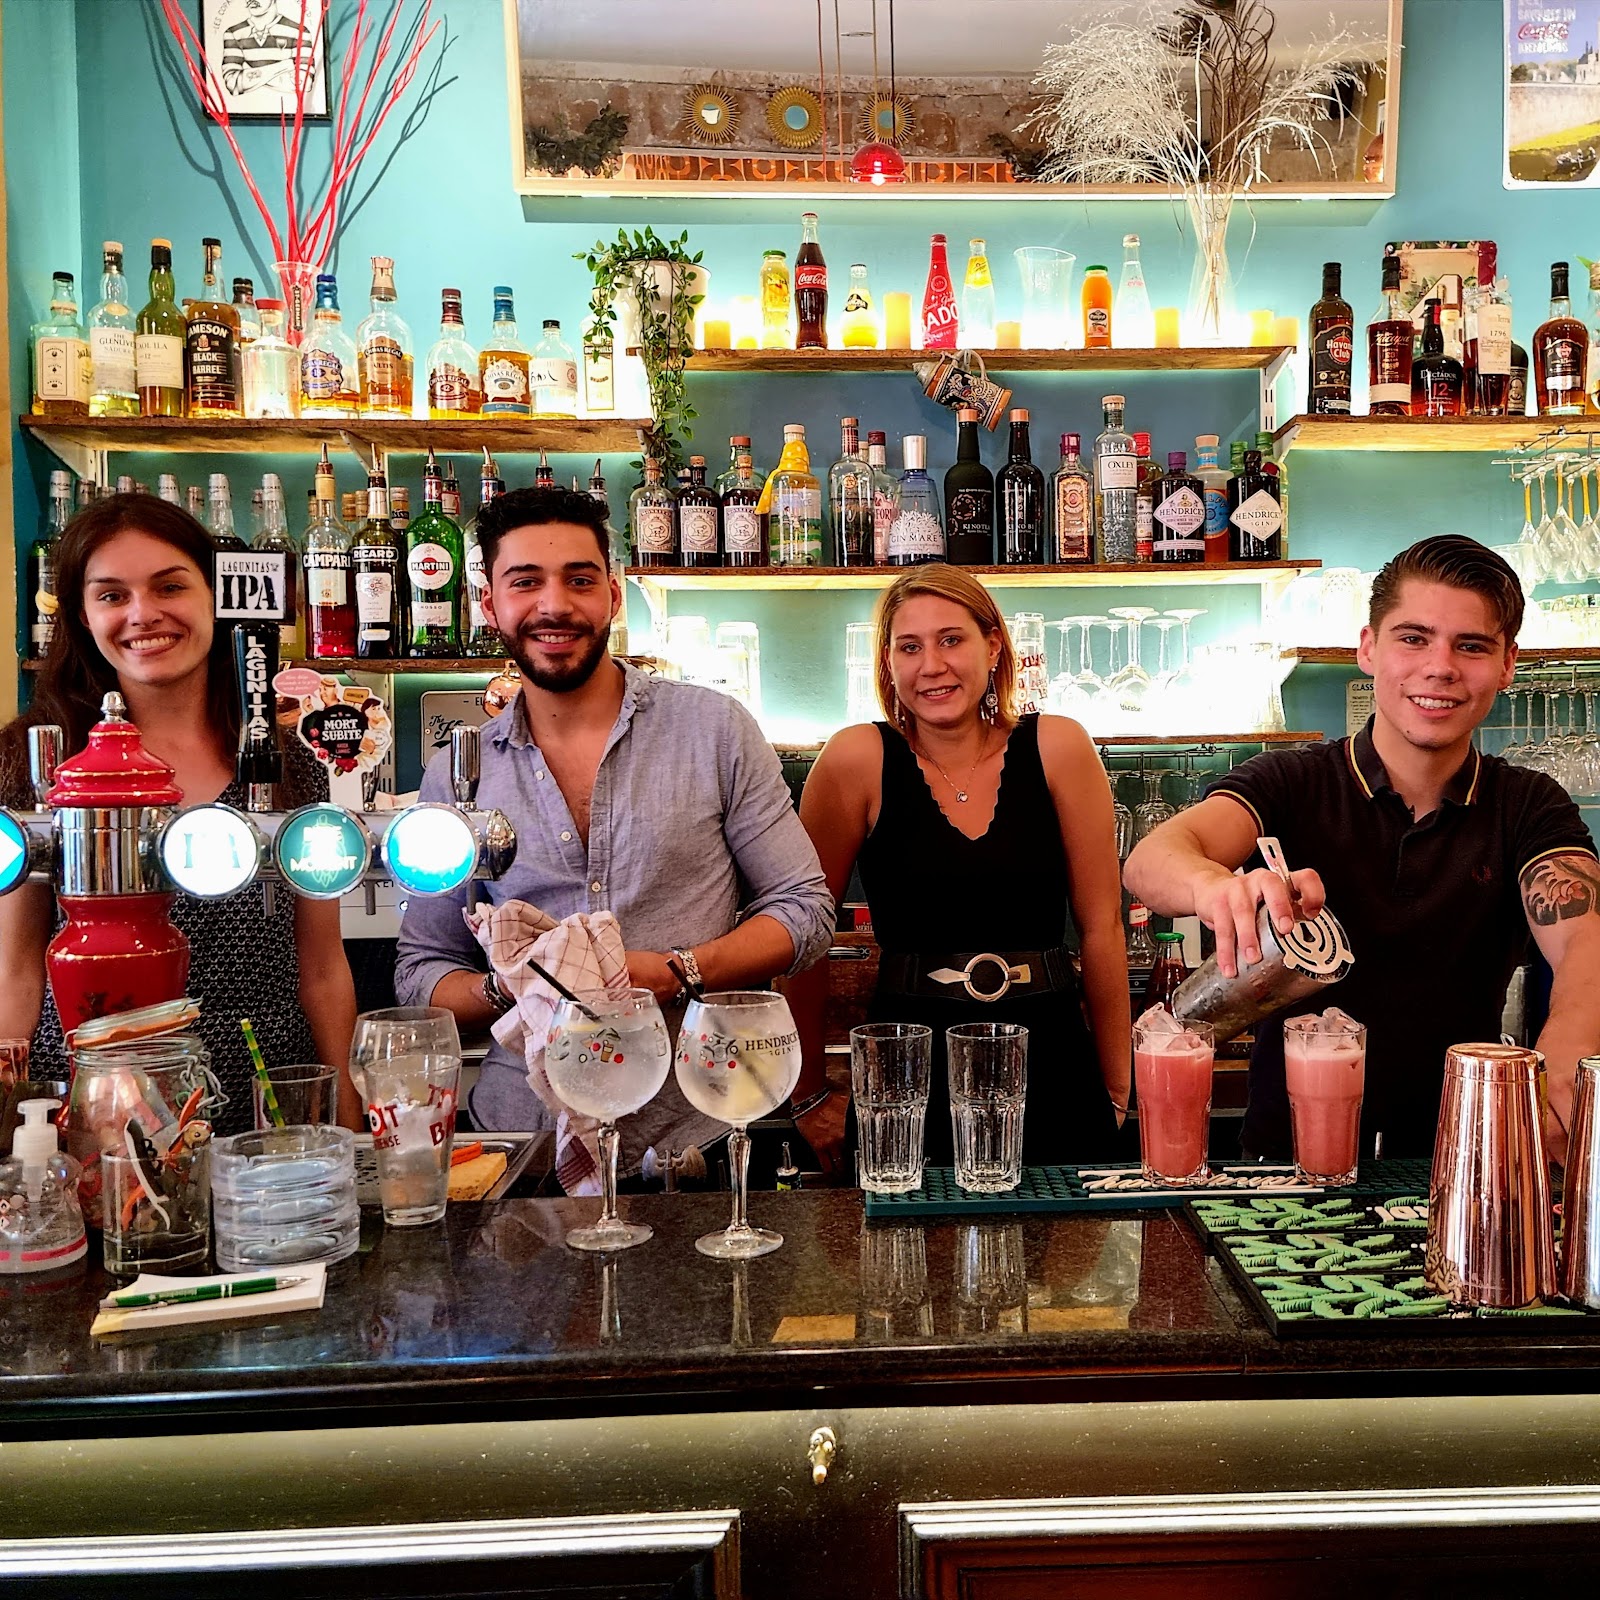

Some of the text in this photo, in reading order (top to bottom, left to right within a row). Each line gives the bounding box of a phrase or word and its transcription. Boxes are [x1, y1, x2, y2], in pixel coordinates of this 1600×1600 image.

[99, 337, 136, 349] GLENLIVE
[193, 352, 218, 362] BLACK
[1333, 348, 1351, 358] Club
[193, 364, 222, 375] BARREL
[1433, 383, 1449, 396] 12
[1107, 460, 1135, 469] OXLEY
[891, 533, 938, 544] GIN MARE
[353, 549, 395, 559] RICARD
[303, 553, 351, 568] CAMPARI
[411, 561, 449, 571] MARTINI
[222, 561, 270, 573] LAGUNITAS
[220, 574, 279, 611] IPA
[245, 635, 269, 740] LAGUNITAS
[324, 719, 359, 731] MORT
[321, 730, 363, 742] SUBITE
